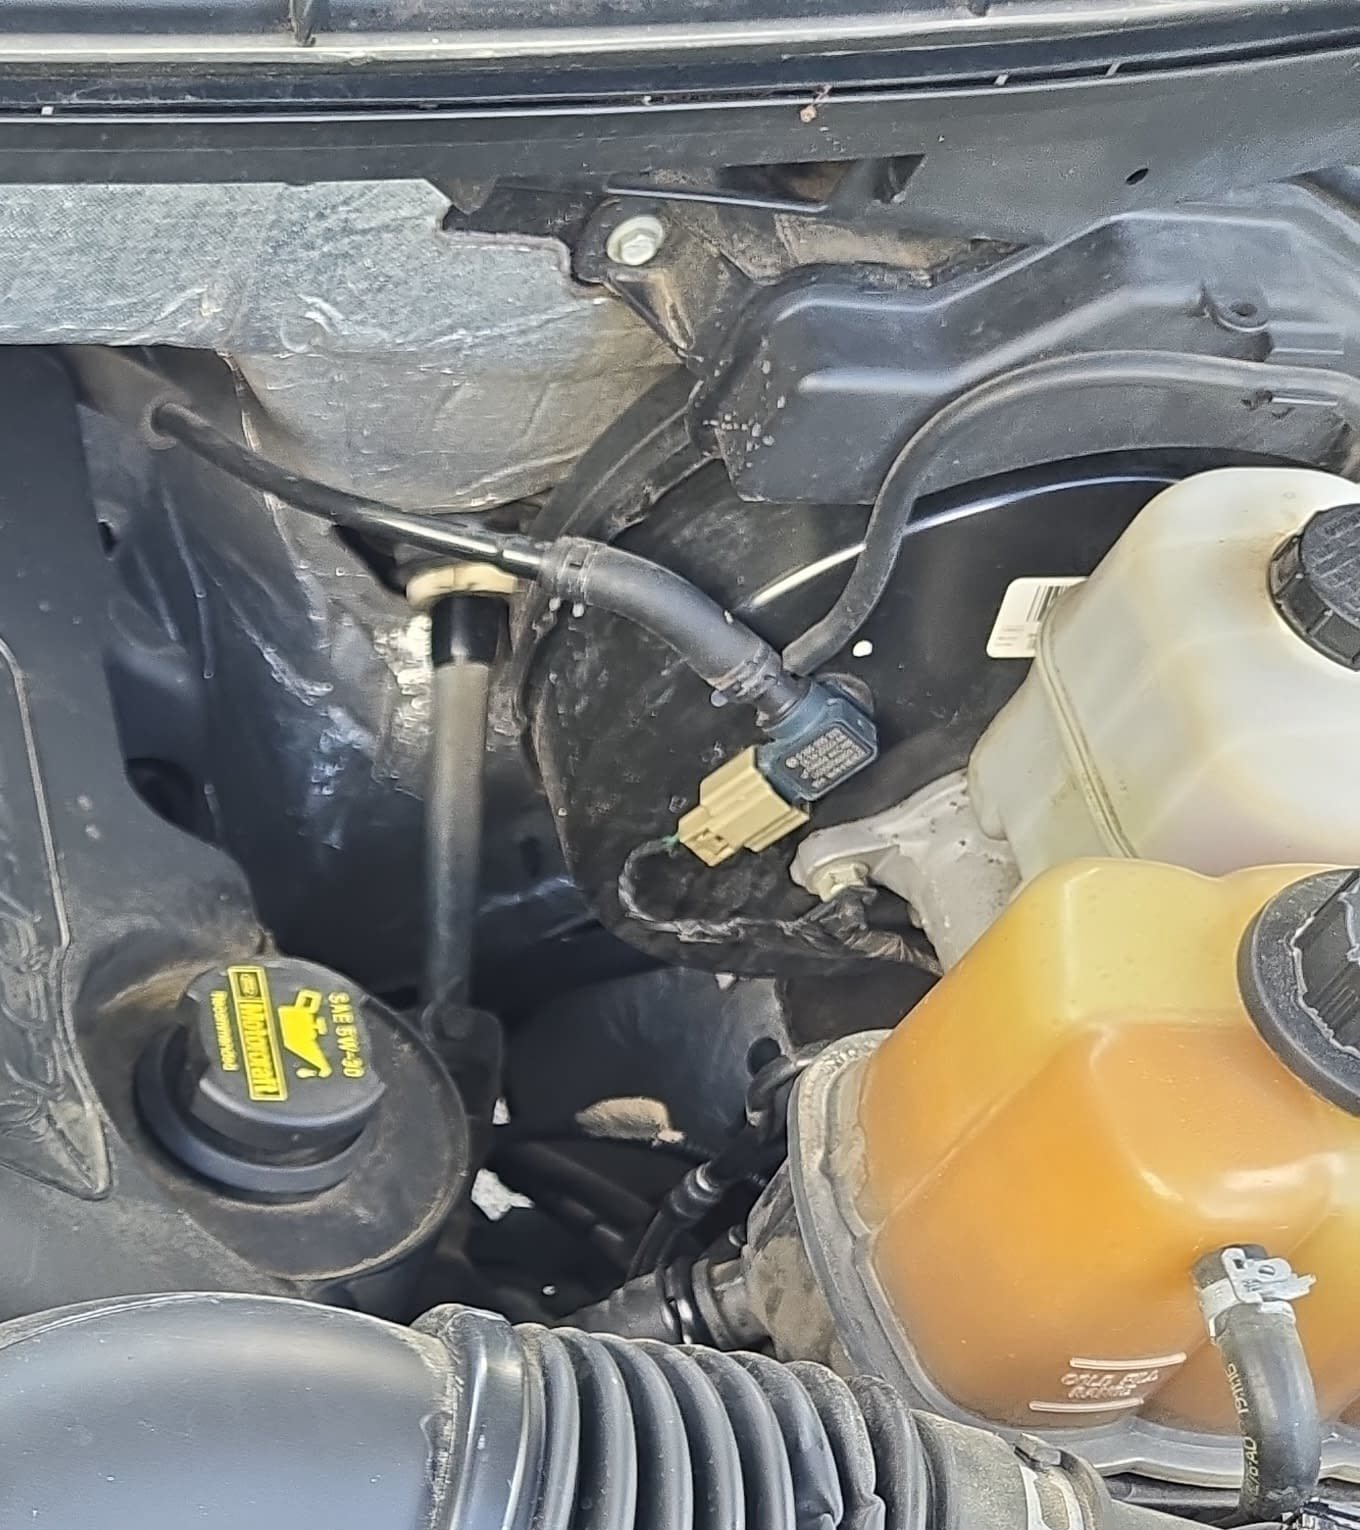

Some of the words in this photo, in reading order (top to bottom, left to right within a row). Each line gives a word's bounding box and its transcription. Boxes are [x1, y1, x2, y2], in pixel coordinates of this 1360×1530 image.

[210, 990, 240, 1071] Recommended
[328, 991, 354, 1024] SAE
[238, 1001, 281, 1094] Motorcraft
[335, 1025, 366, 1079] 5W-30
